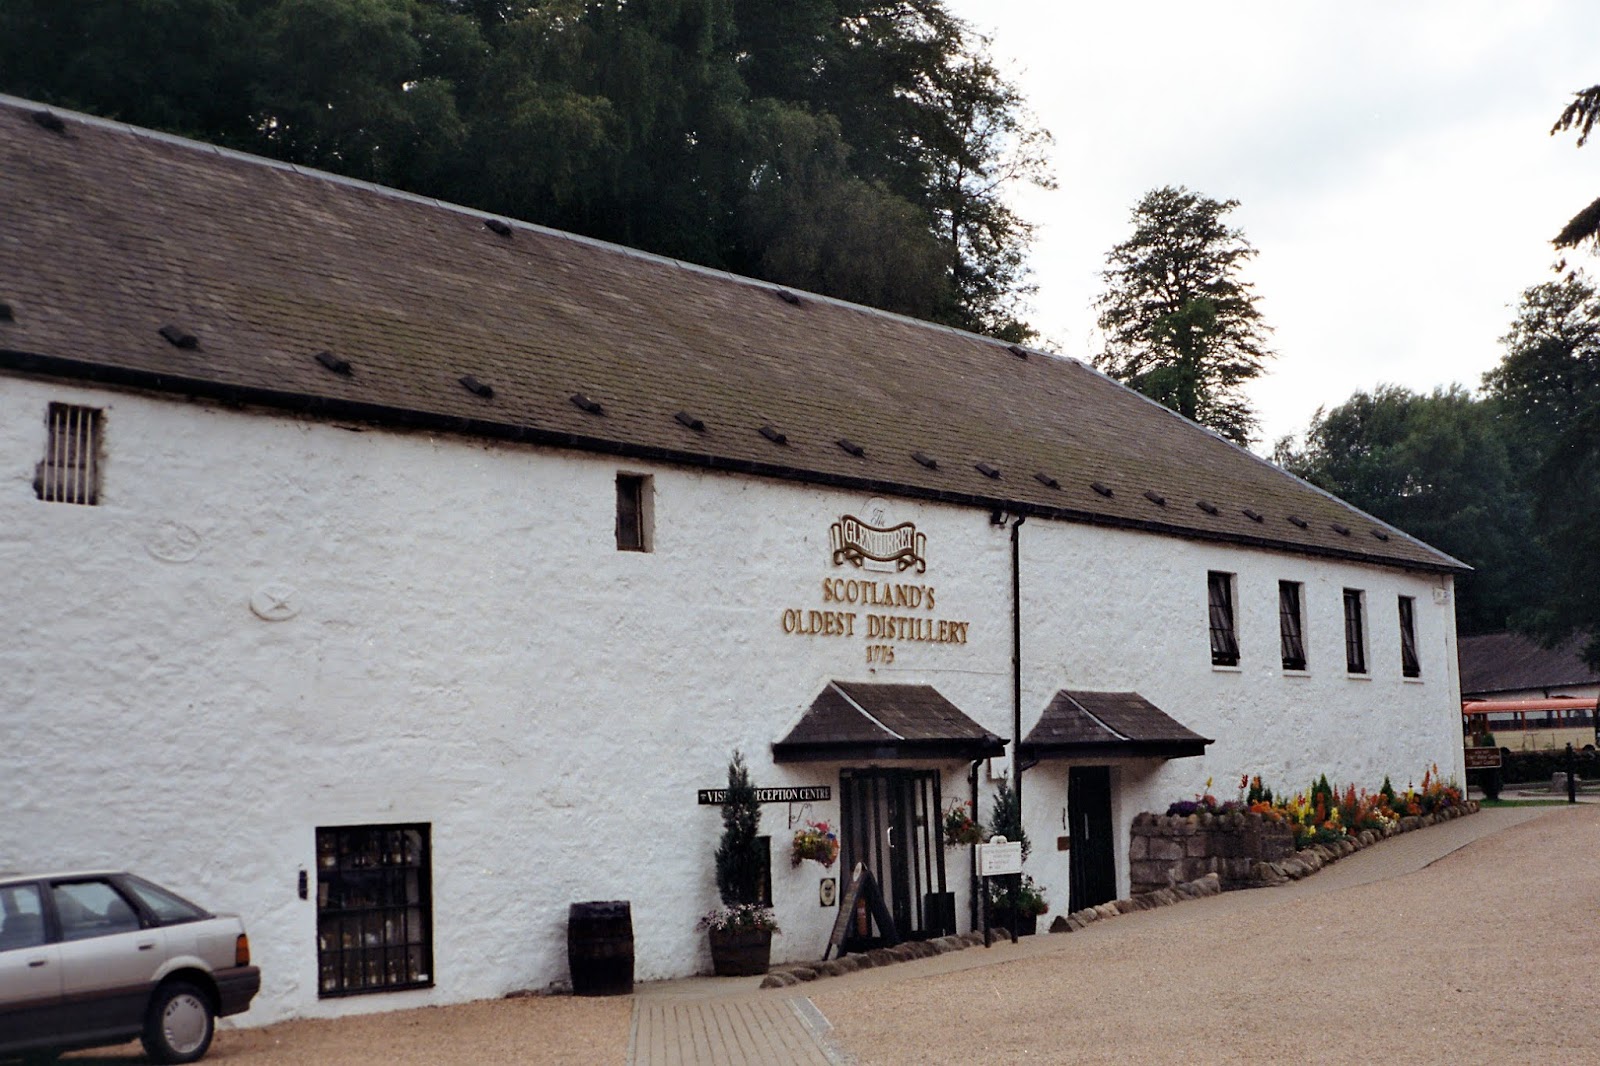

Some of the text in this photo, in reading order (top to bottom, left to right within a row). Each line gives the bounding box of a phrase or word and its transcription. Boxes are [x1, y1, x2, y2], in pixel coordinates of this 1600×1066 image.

[823, 577, 936, 610] SCOTLAND'S
[782, 609, 970, 644] OLDEST DISTILLERY
[866, 645, 895, 664] 1775
[753, 789, 798, 801] ECEPTION
[800, 788, 830, 800] CENTRE
